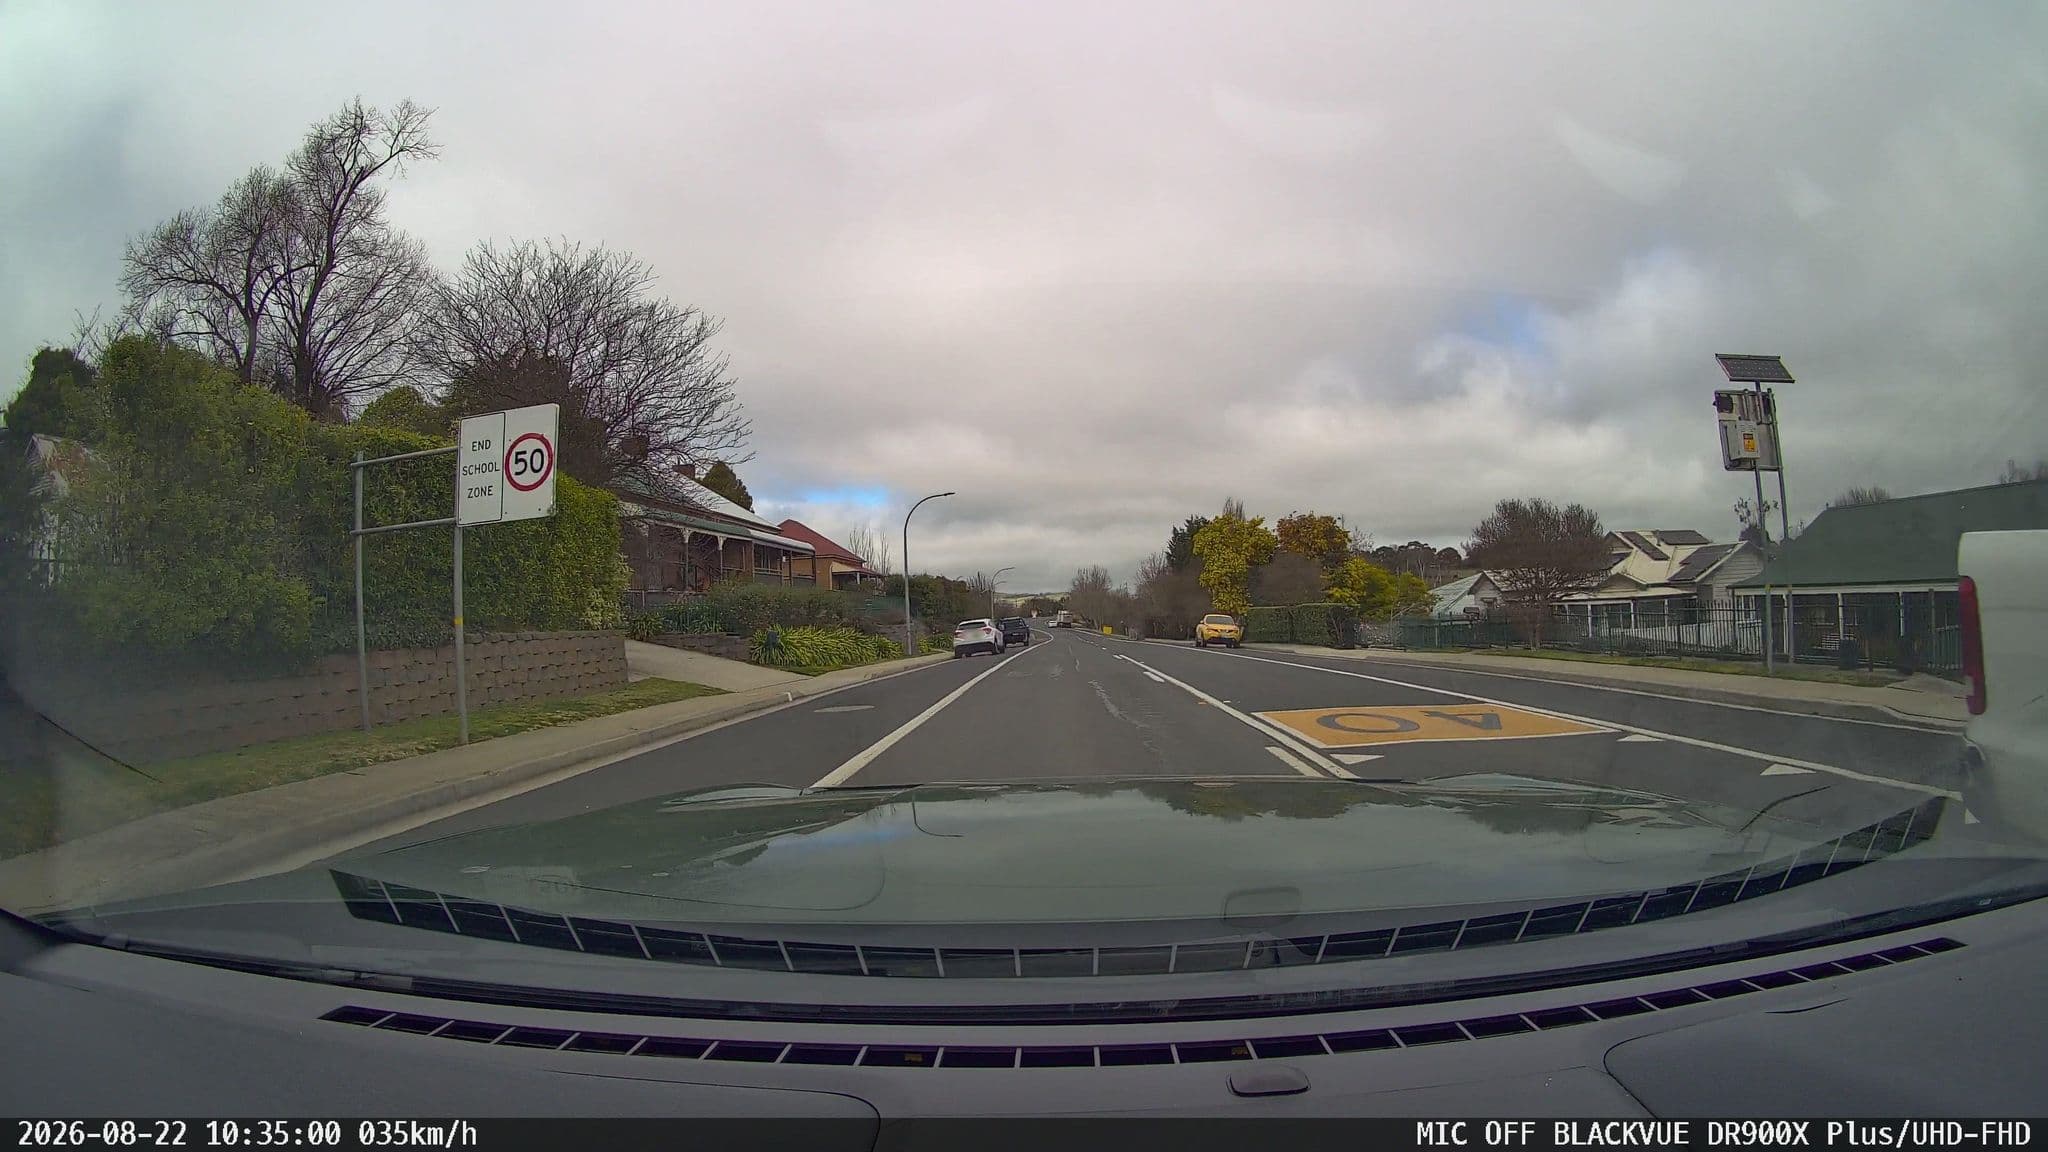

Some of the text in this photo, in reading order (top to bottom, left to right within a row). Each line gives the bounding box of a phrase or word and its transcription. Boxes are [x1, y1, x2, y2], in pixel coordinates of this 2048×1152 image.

[471, 439, 491, 452] END
[462, 462, 500, 476] SCHOOL
[514, 448, 545, 476] 50
[467, 485, 494, 499] ZONE
[1316, 710, 1502, 733] 40
